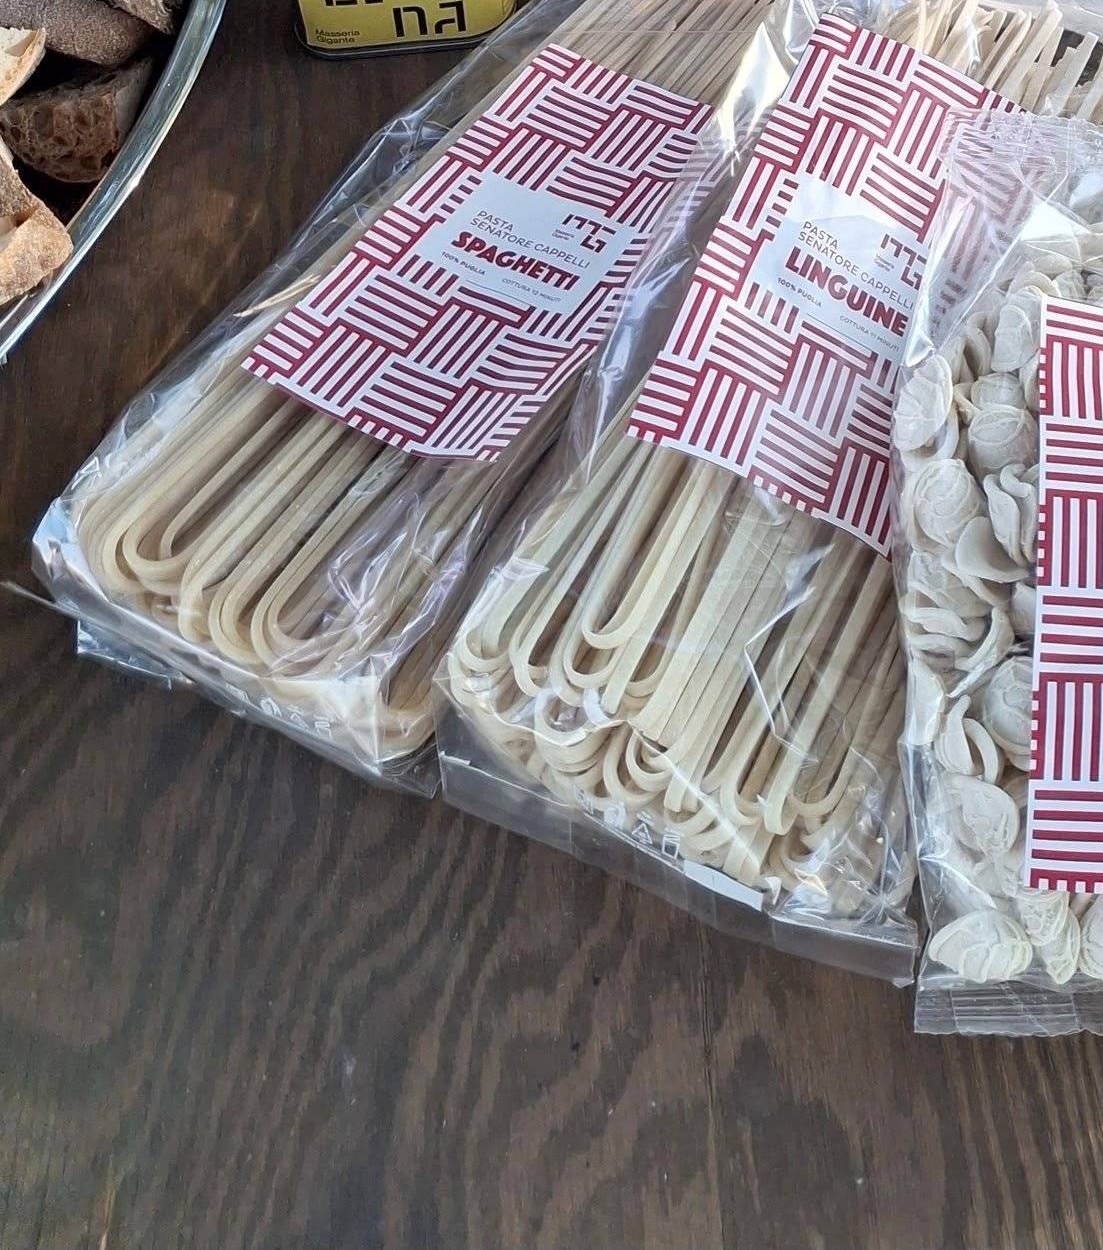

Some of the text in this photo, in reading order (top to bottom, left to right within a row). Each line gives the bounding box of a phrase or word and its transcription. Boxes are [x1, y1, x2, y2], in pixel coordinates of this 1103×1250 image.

[315, 29, 360, 38] Masseria
[477, 209, 514, 231] PASTA
[802, 221, 839, 249] PASTA
[470, 217, 533, 249] SENATORE
[534, 242, 591, 269] CAPPELLI
[450, 231, 580, 291] SPAGHETTI
[460, 260, 486, 276] PUGLIA
[798, 231, 860, 276] SENATORE
[860, 270, 914, 311] CAPPELLI
[777, 276, 822, 308] 100% PUGLIA
[785, 246, 909, 338] LINGUINE
